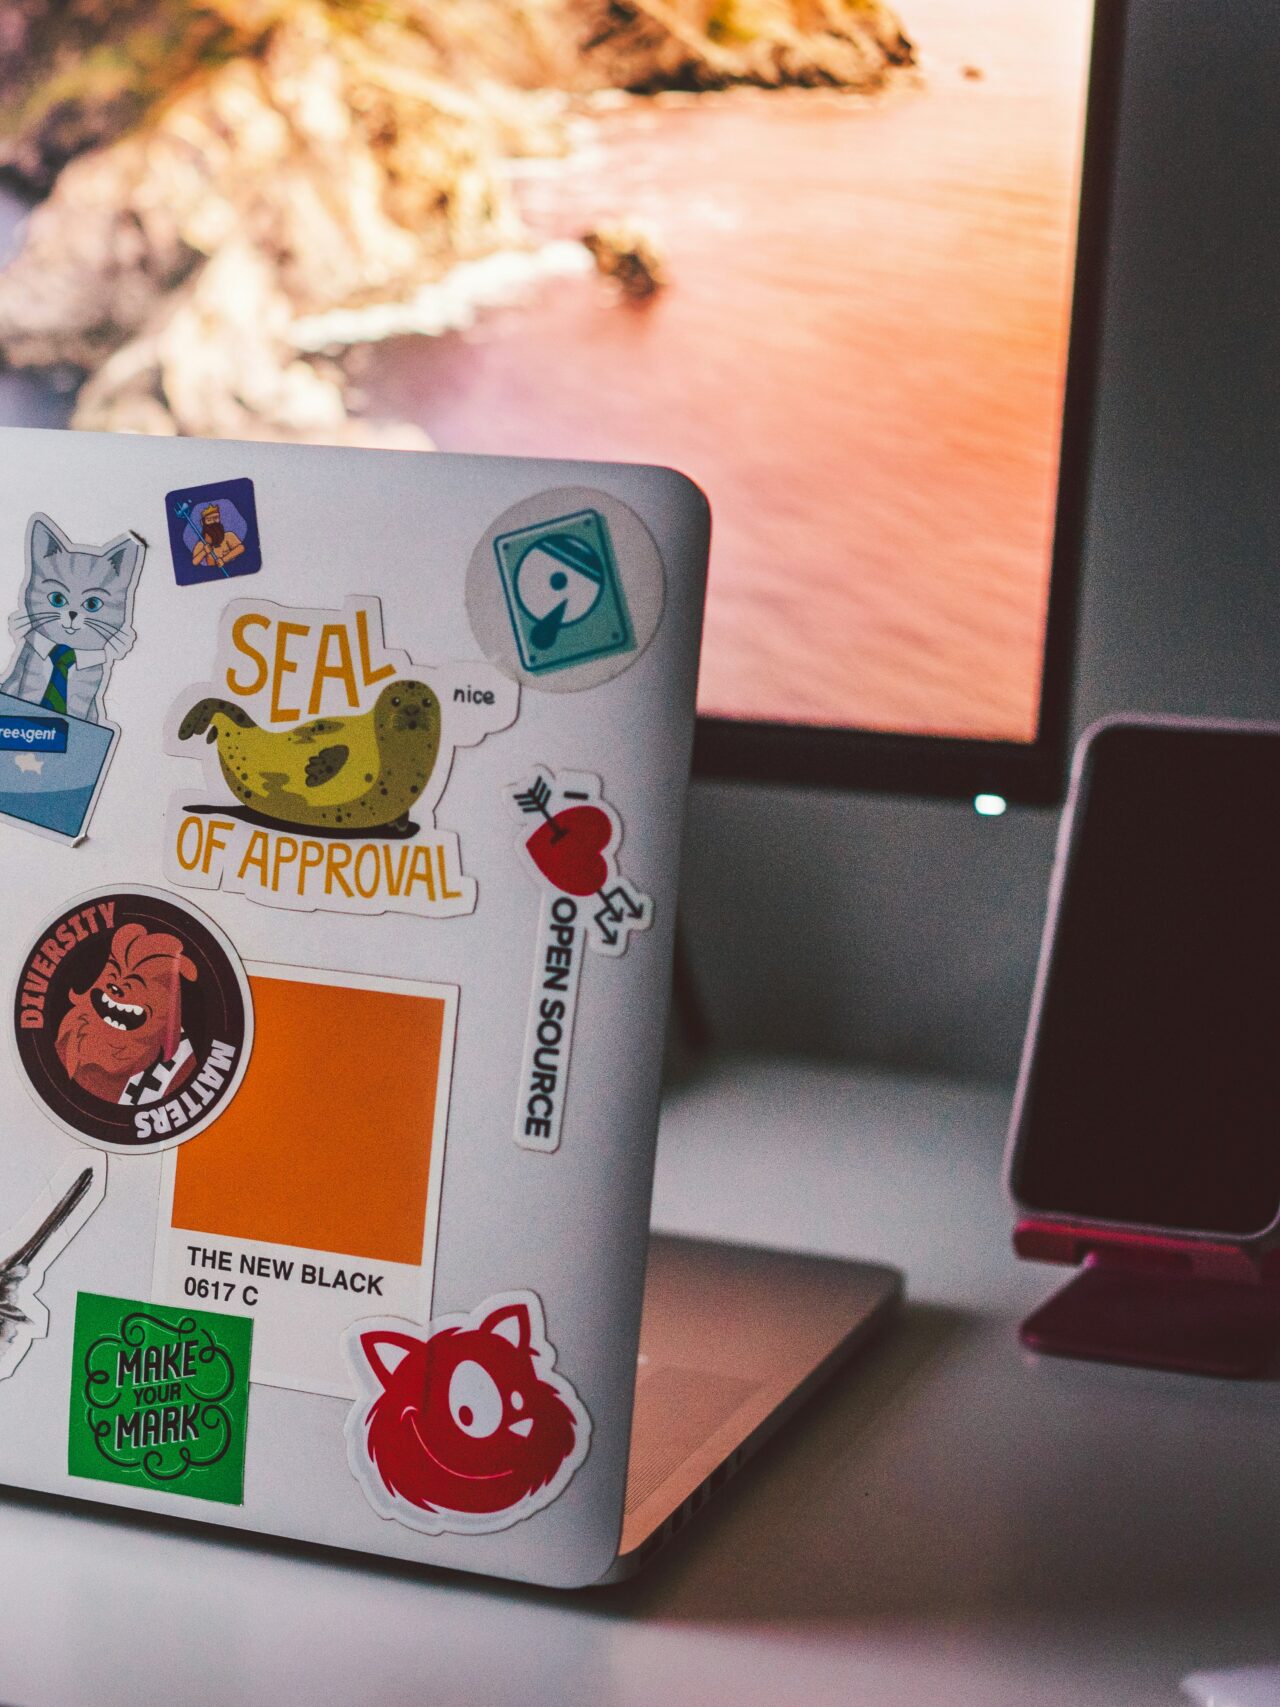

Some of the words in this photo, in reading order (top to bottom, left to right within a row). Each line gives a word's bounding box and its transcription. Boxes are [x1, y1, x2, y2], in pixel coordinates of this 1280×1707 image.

[226, 610, 396, 723] SEAL
[453, 685, 495, 705] nice
[176, 816, 236, 874] OF
[236, 830, 463, 901] APPROVAL
[21, 901, 116, 1029] DIVERSITY
[543, 897, 577, 992] OPEN
[134, 1039, 236, 1138] MATTERS
[524, 997, 566, 1139] SOURCE
[184, 1276, 236, 1302] 0617
[242, 1285, 259, 1306] C
[187, 1246, 232, 1272] THE
[239, 1254, 294, 1281] NEW
[301, 1265, 384, 1296] BLACK
[115, 1339, 199, 1388] MAKE
[132, 1381, 182, 1407] YOUR
[113, 1403, 200, 1451] MARK
